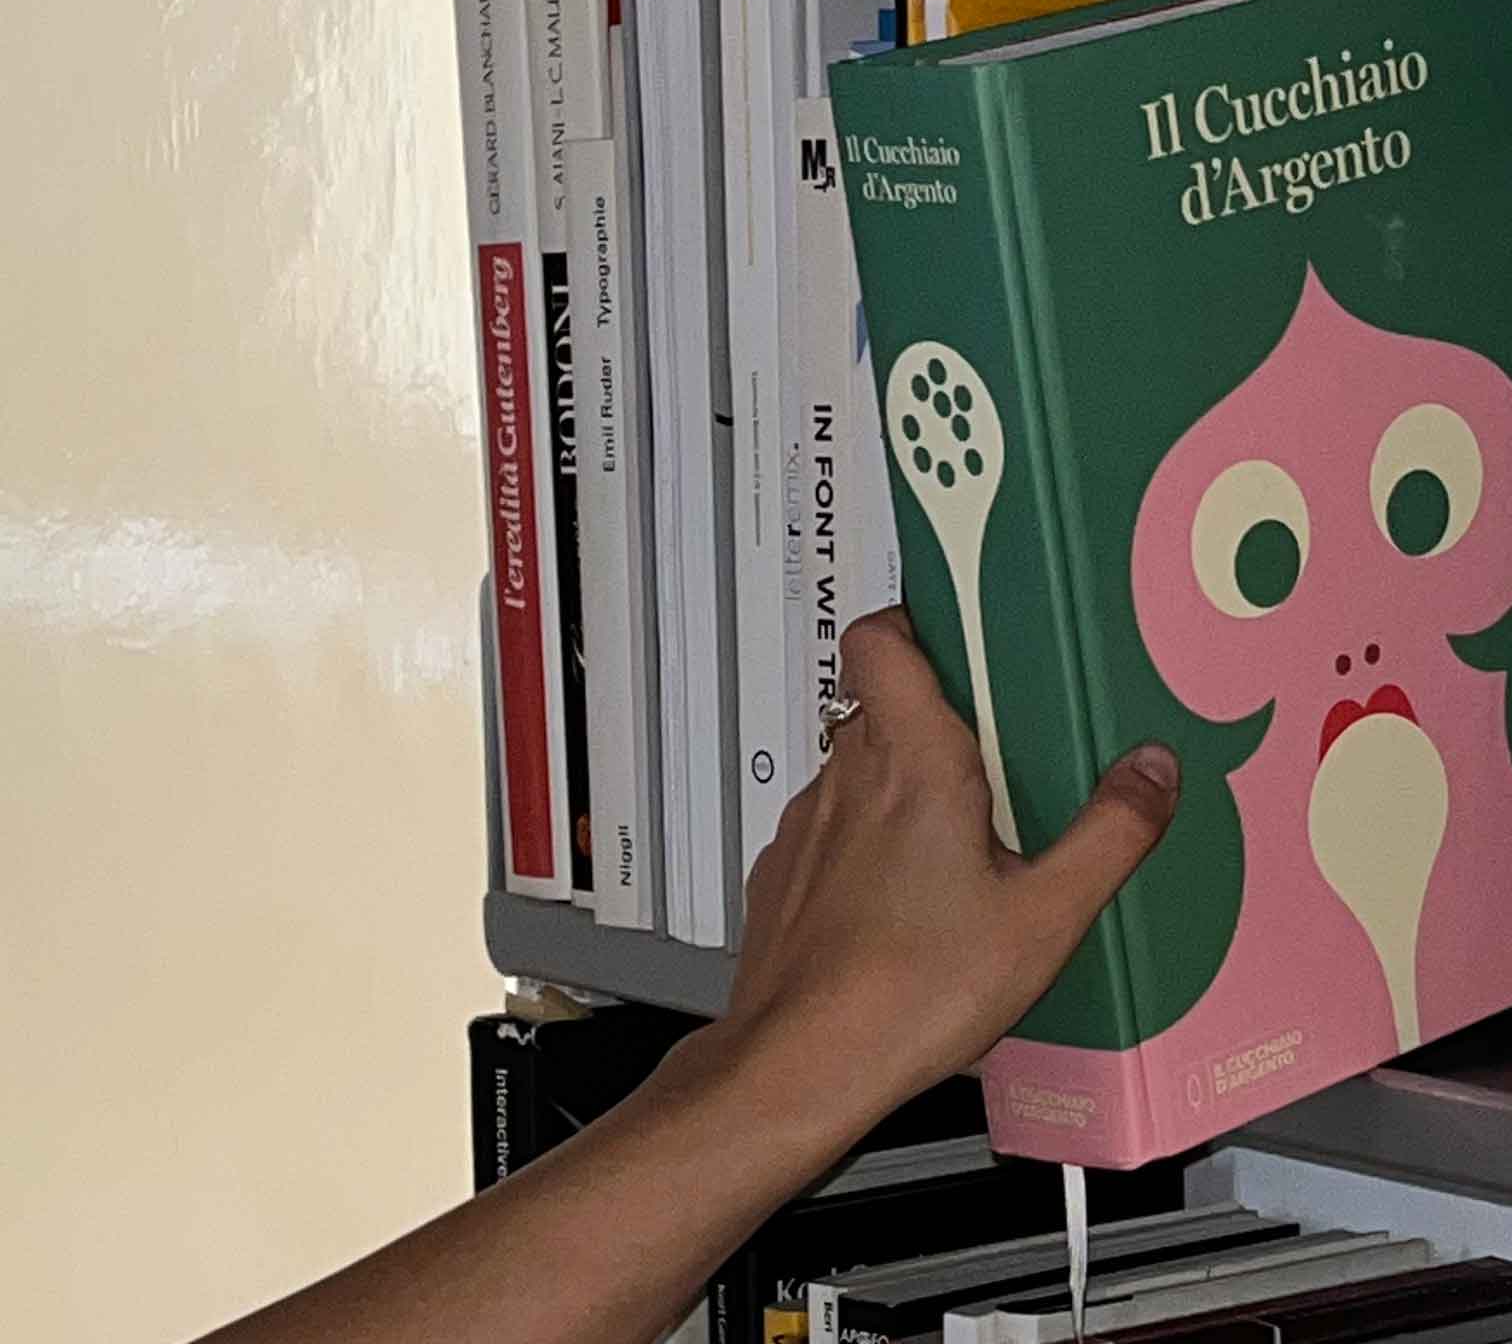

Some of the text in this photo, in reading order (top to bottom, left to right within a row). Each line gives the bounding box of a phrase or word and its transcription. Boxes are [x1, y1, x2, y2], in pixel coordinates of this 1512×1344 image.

[1140, 41, 1428, 161] Il Cucchiaio
[862, 176, 958, 209] d'Argento
[1180, 126, 1411, 226] d'Argento
[592, 196, 613, 328] Typographie
[489, 255, 521, 456] Gutenberg
[597, 356, 616, 472] Emil Ruder
